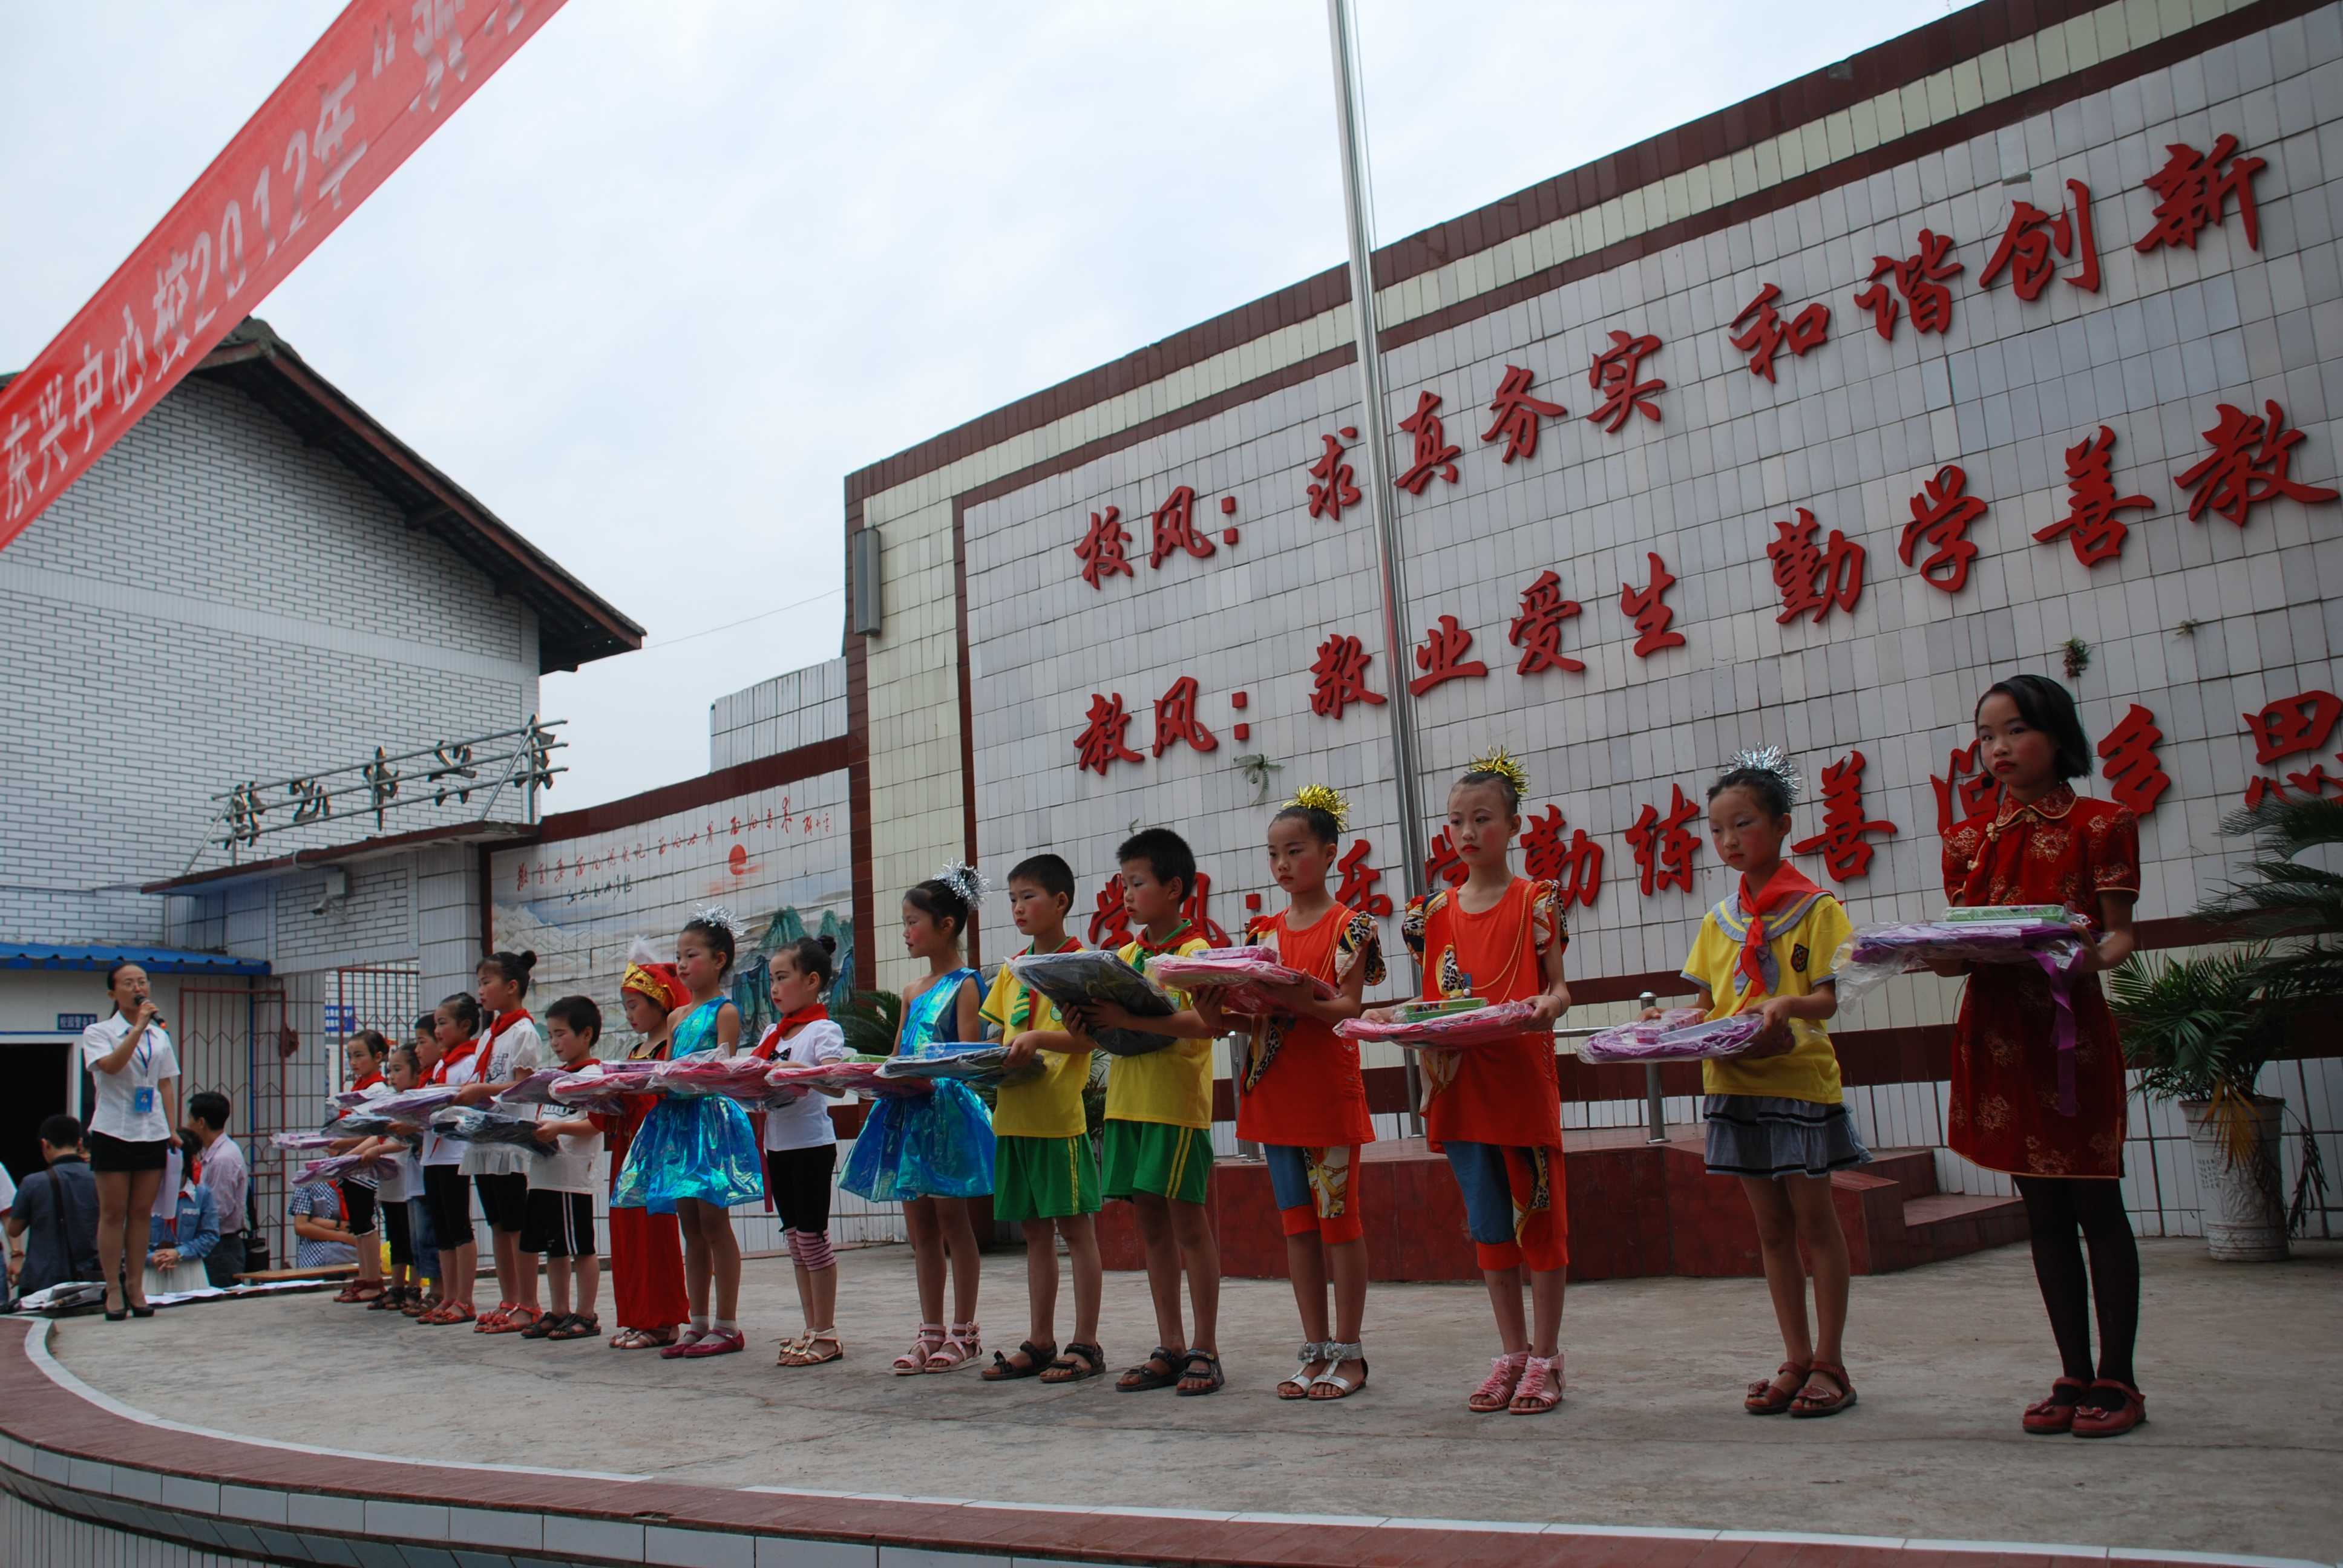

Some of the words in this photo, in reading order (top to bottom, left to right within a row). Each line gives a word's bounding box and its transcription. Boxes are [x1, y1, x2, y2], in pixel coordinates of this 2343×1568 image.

[1306, 330, 1666, 522] 求真务实
[1728, 132, 2267, 384] 和谐创新
[1309, 552, 1686, 720] 敬业爱生
[1766, 399, 2341, 624] 勤学善教
